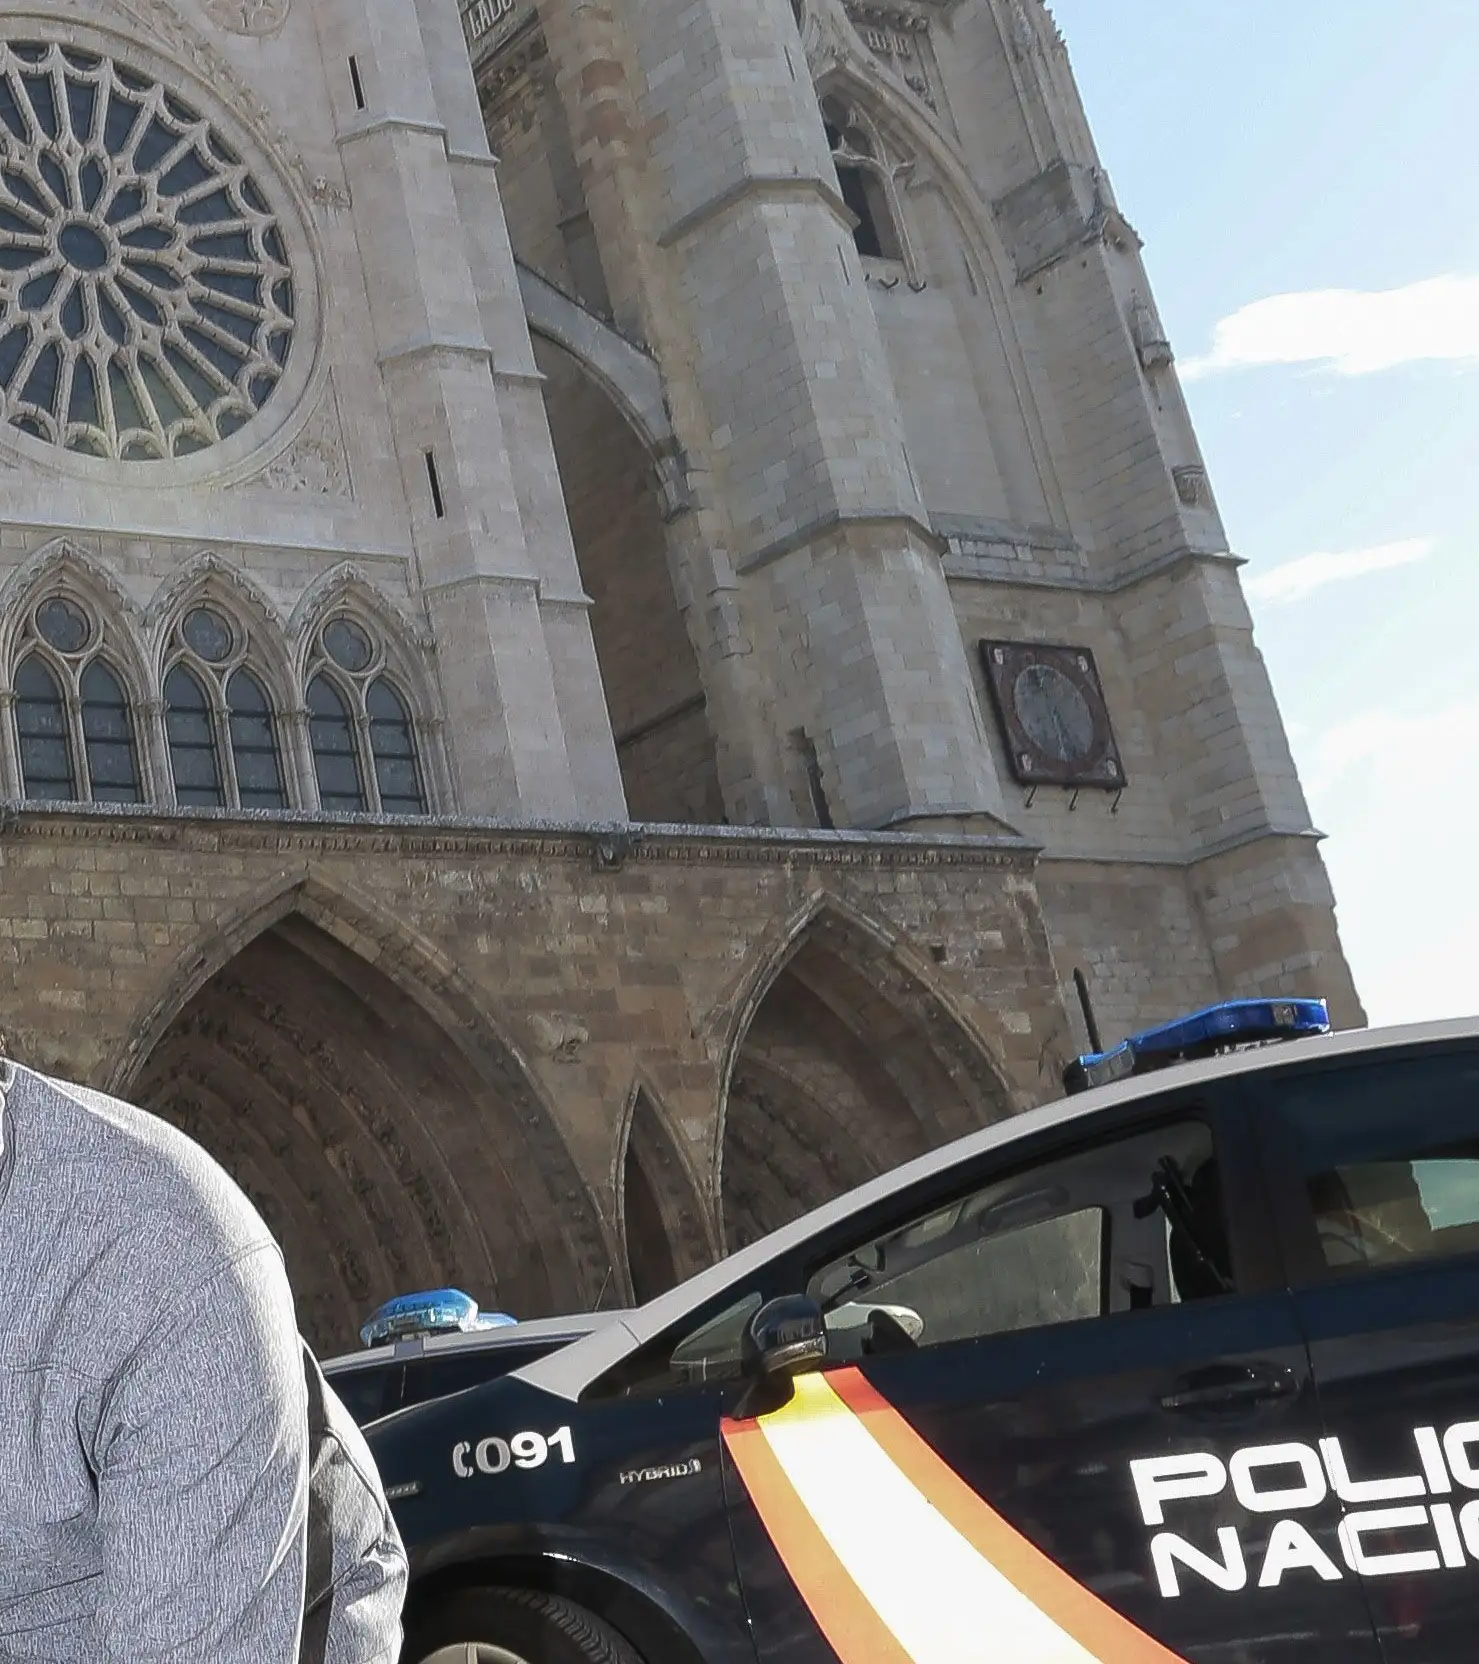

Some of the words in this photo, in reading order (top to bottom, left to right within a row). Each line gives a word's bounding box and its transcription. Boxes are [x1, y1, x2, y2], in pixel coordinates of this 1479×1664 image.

[475, 1426, 576, 1474] 091
[620, 1463, 689, 1485] HYBRID
[1150, 1500, 1479, 1598] NACI
